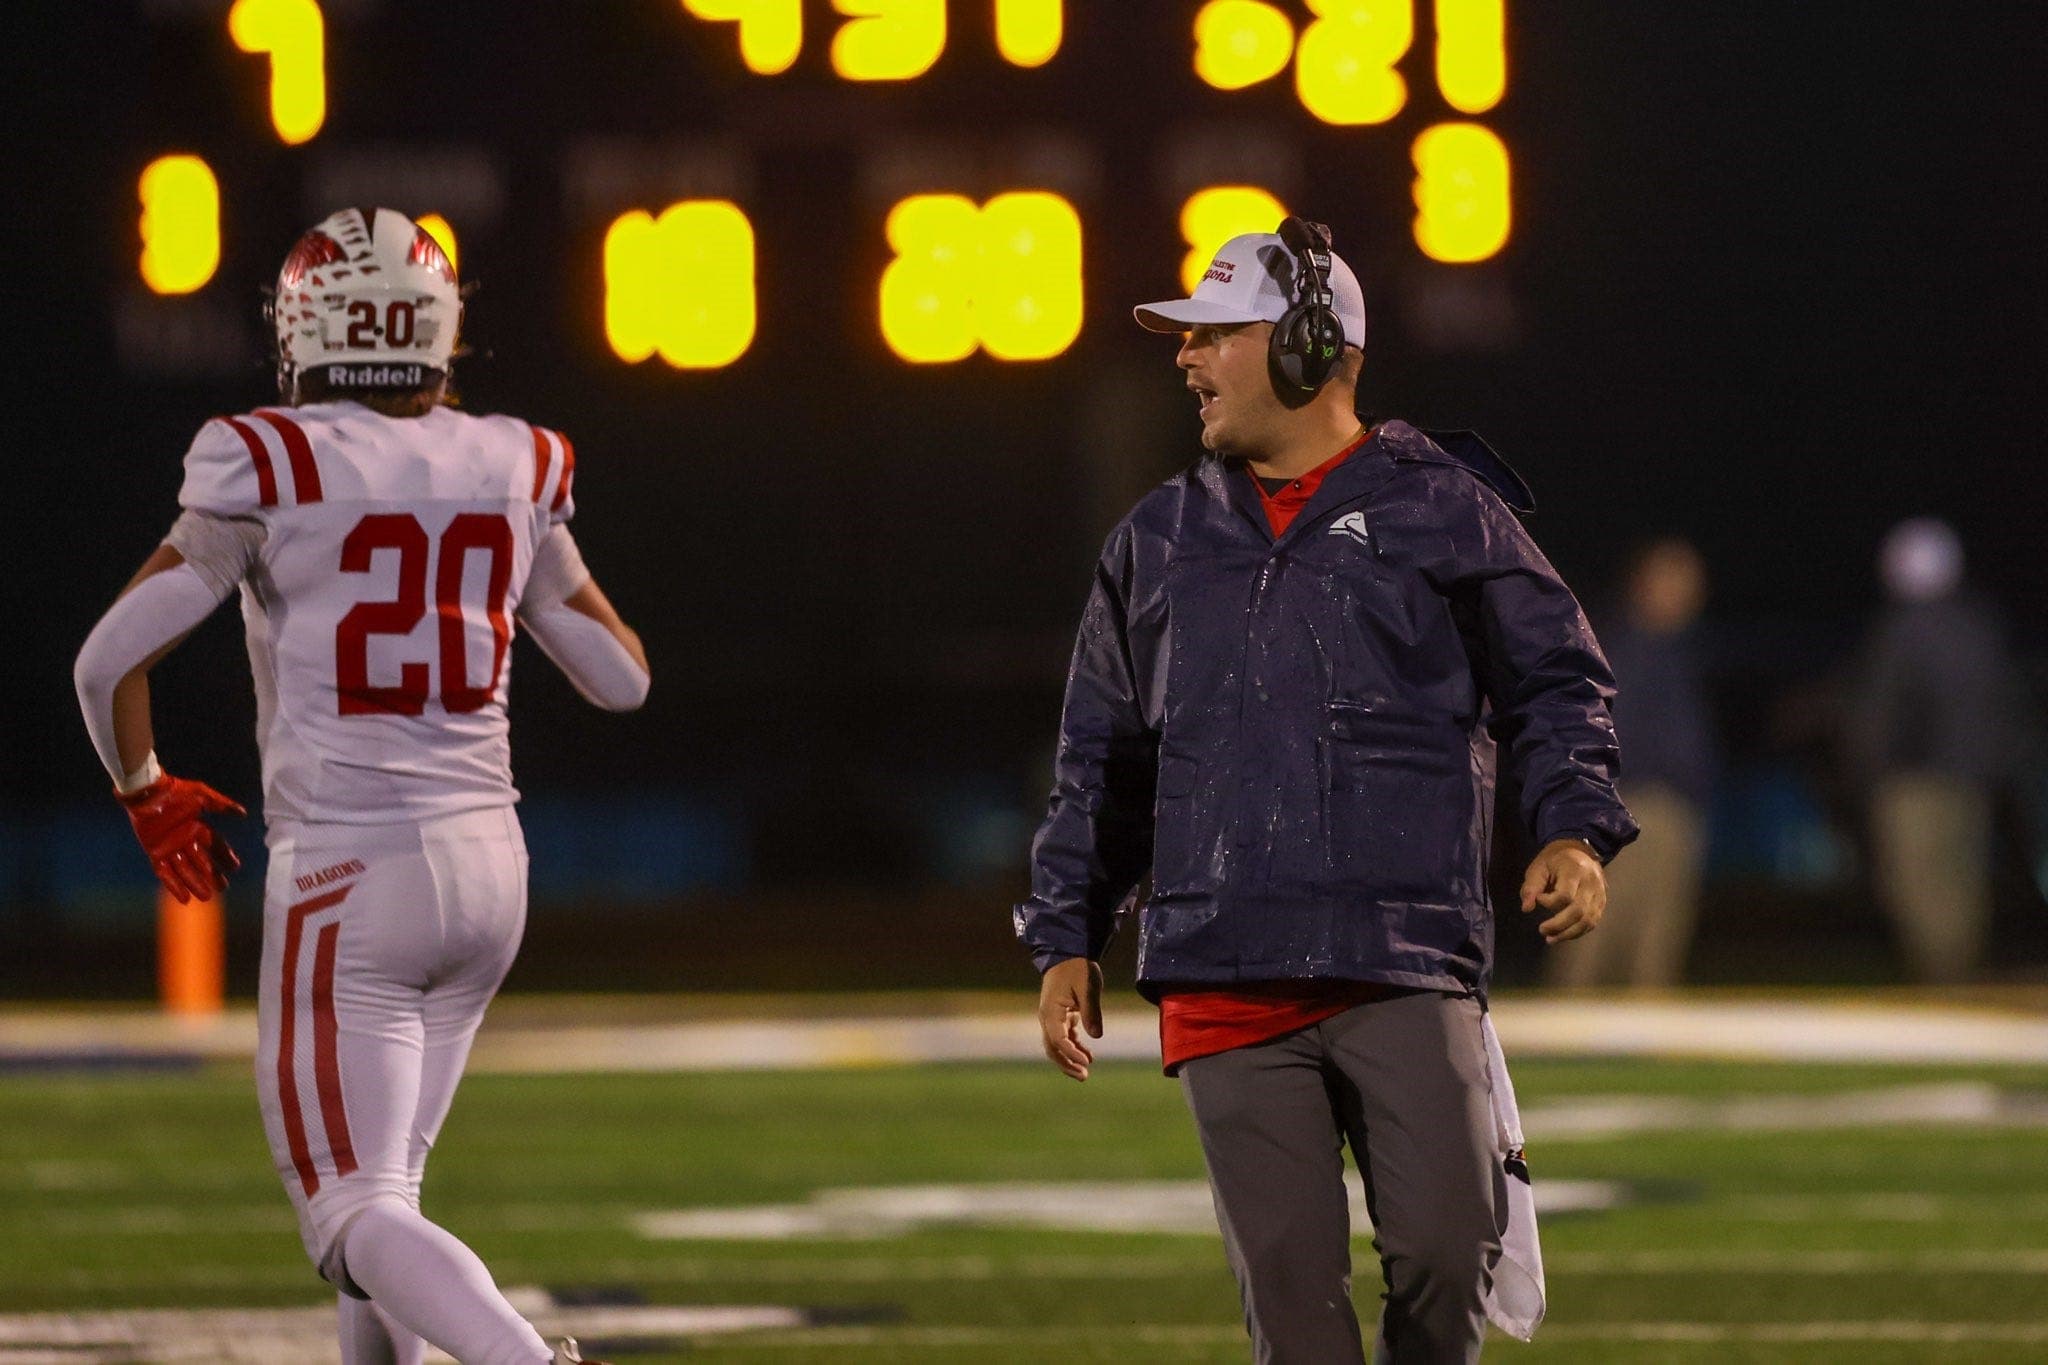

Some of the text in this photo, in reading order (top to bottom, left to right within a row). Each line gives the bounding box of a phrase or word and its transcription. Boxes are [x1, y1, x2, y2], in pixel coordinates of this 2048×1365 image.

[1202, 269, 1233, 284] gons
[347, 300, 414, 350] 20
[329, 366, 422, 386] Riddell
[336, 513, 514, 716] 20
[295, 858, 366, 892] DRAGONS
